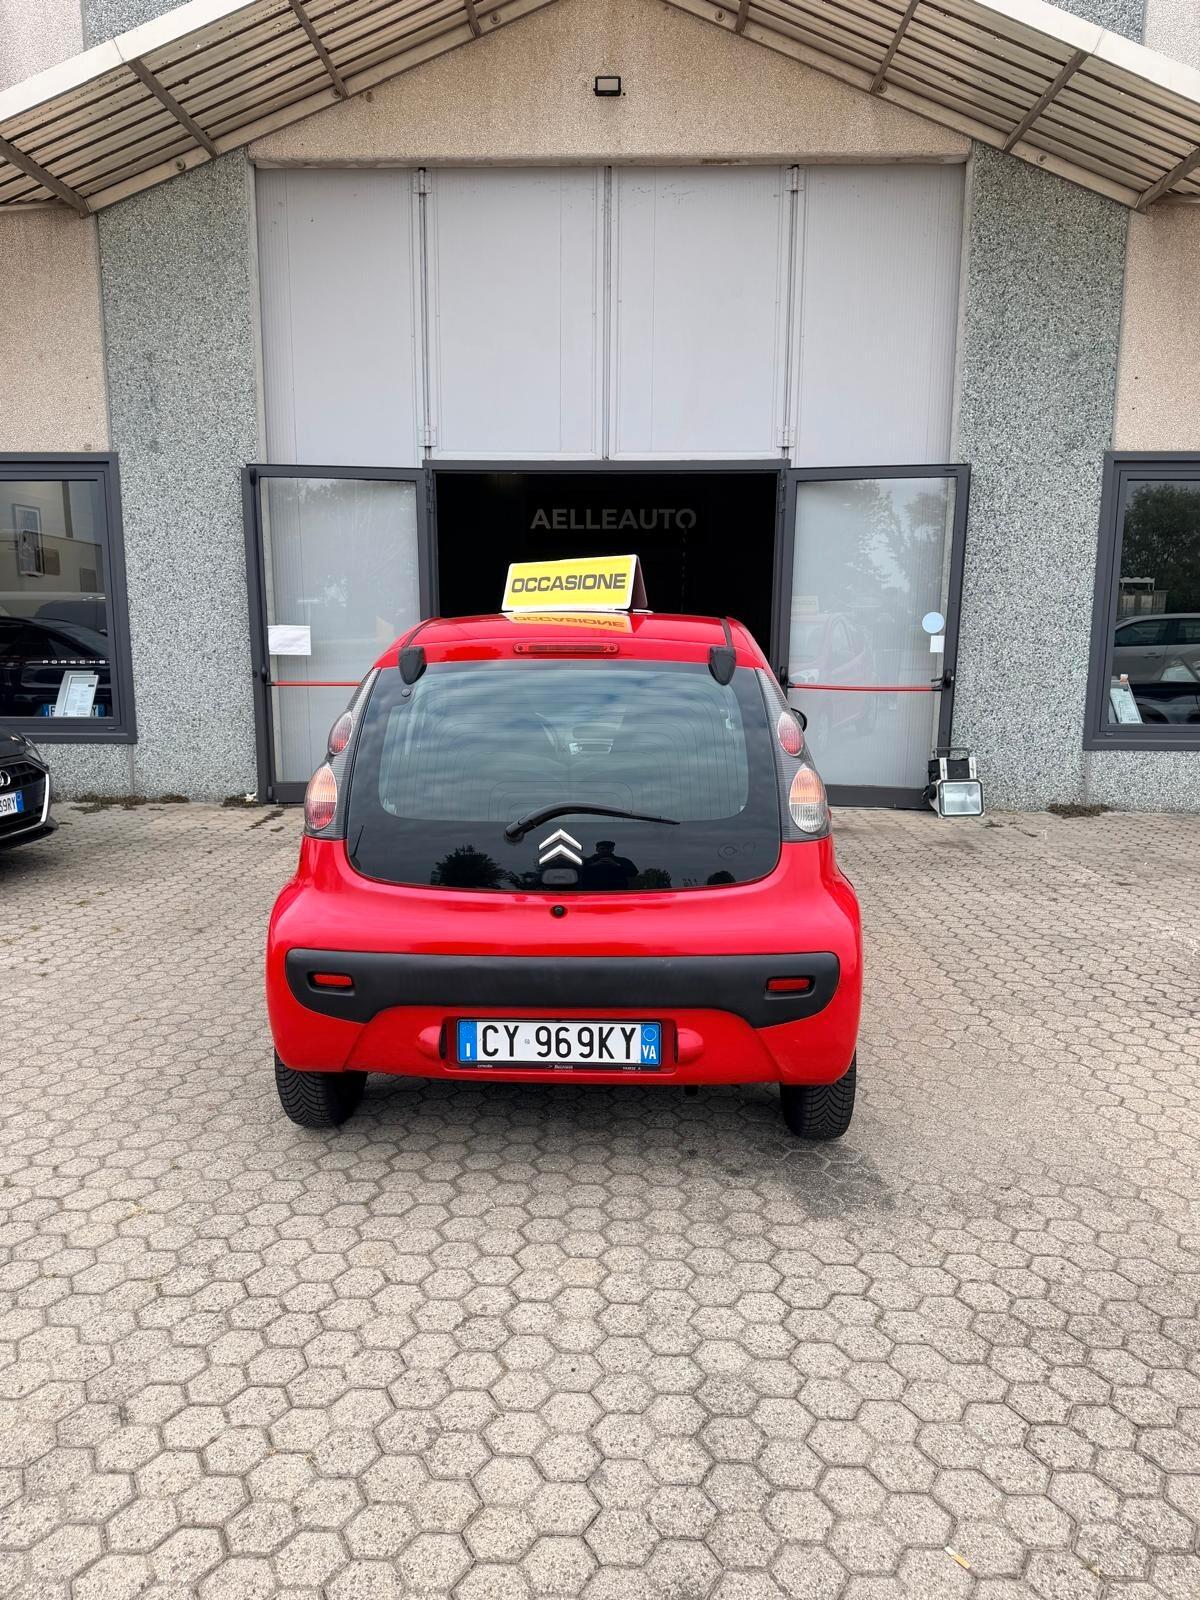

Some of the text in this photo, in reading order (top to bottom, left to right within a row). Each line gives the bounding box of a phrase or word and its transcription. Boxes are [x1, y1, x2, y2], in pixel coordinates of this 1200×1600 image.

[530, 508, 697, 530] AELLEAUTO
[511, 572, 628, 594] OCCASIONE
[466, 1024, 657, 1060] I CY 969KY VA
